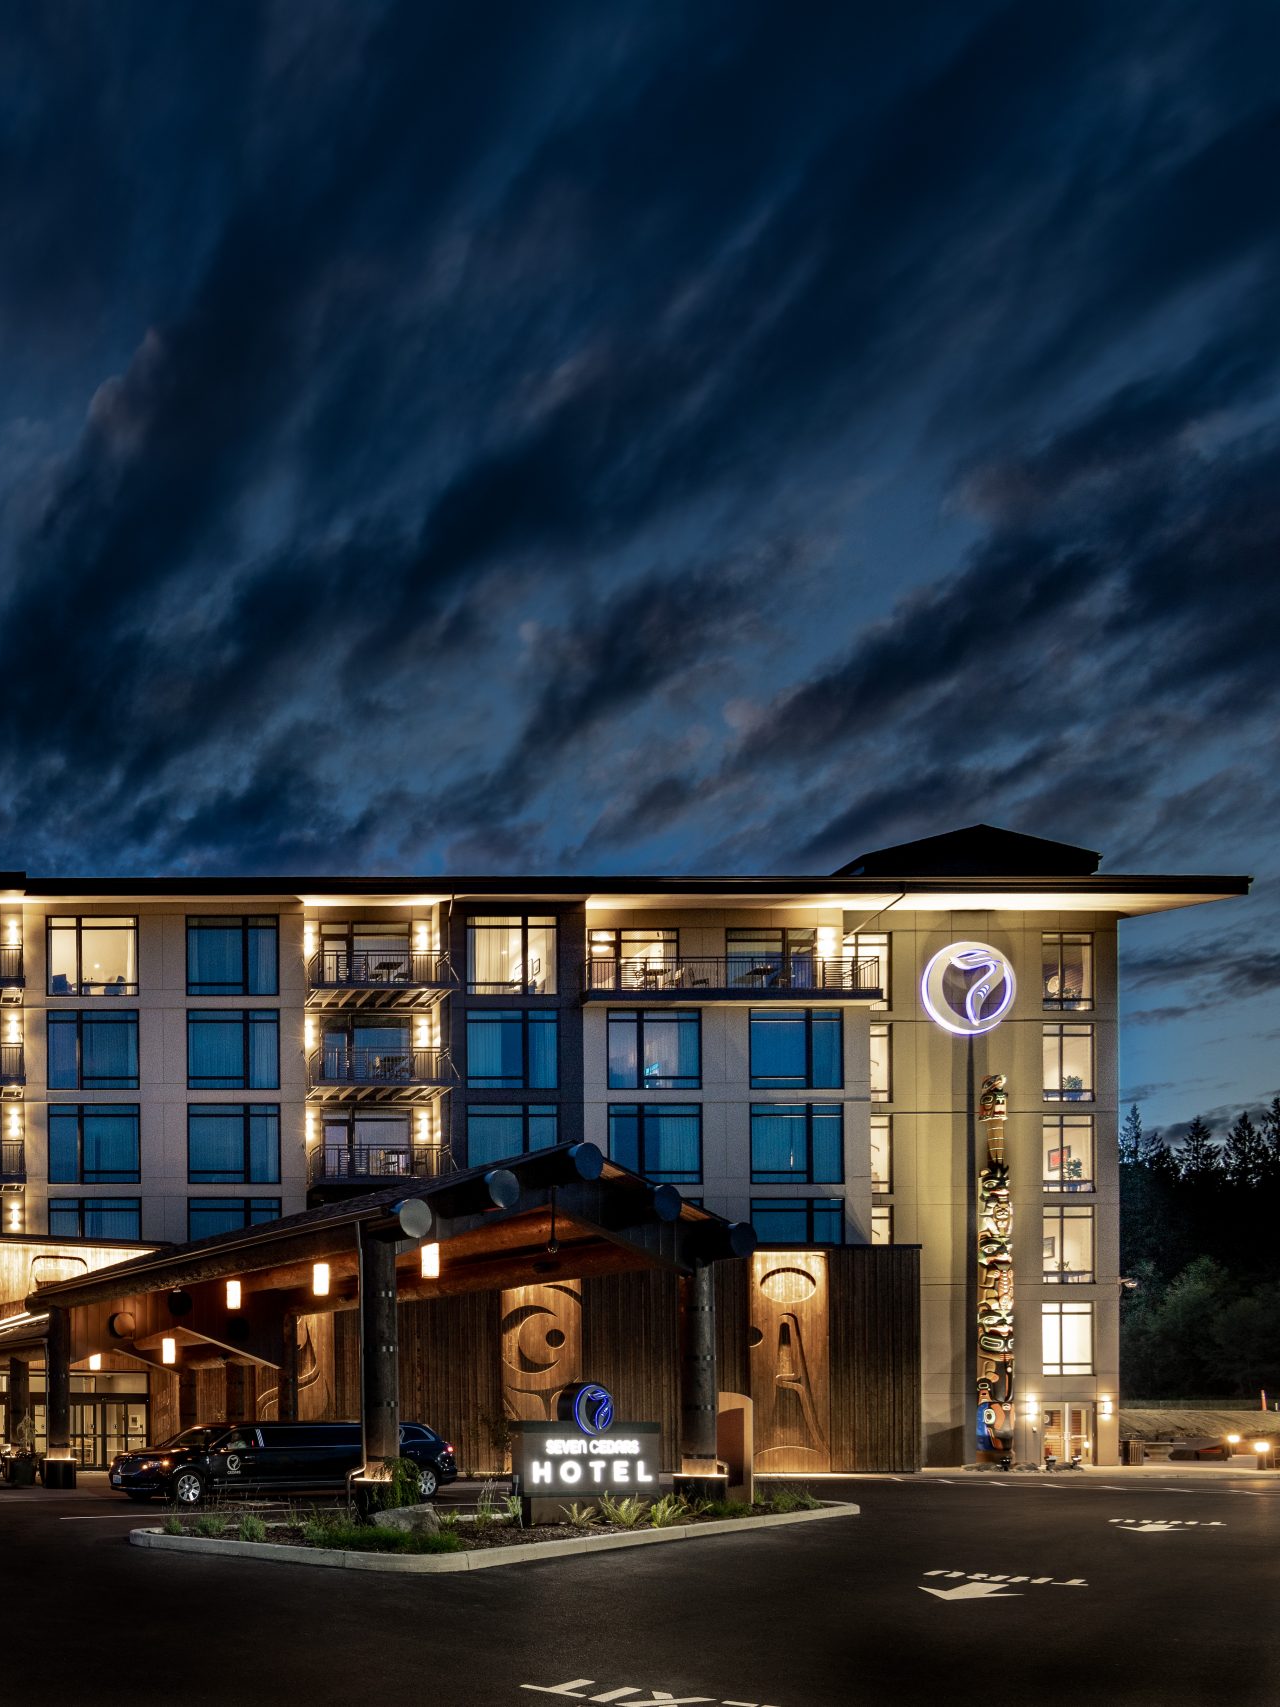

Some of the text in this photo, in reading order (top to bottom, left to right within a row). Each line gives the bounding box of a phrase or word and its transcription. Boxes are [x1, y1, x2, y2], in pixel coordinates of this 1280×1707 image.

[545, 1439, 641, 1455] SEVEN CEDARS
[532, 1460, 654, 1484] HOTEL
[923, 1569, 1090, 1587] THRU
[519, 1678, 781, 1707] XIT
